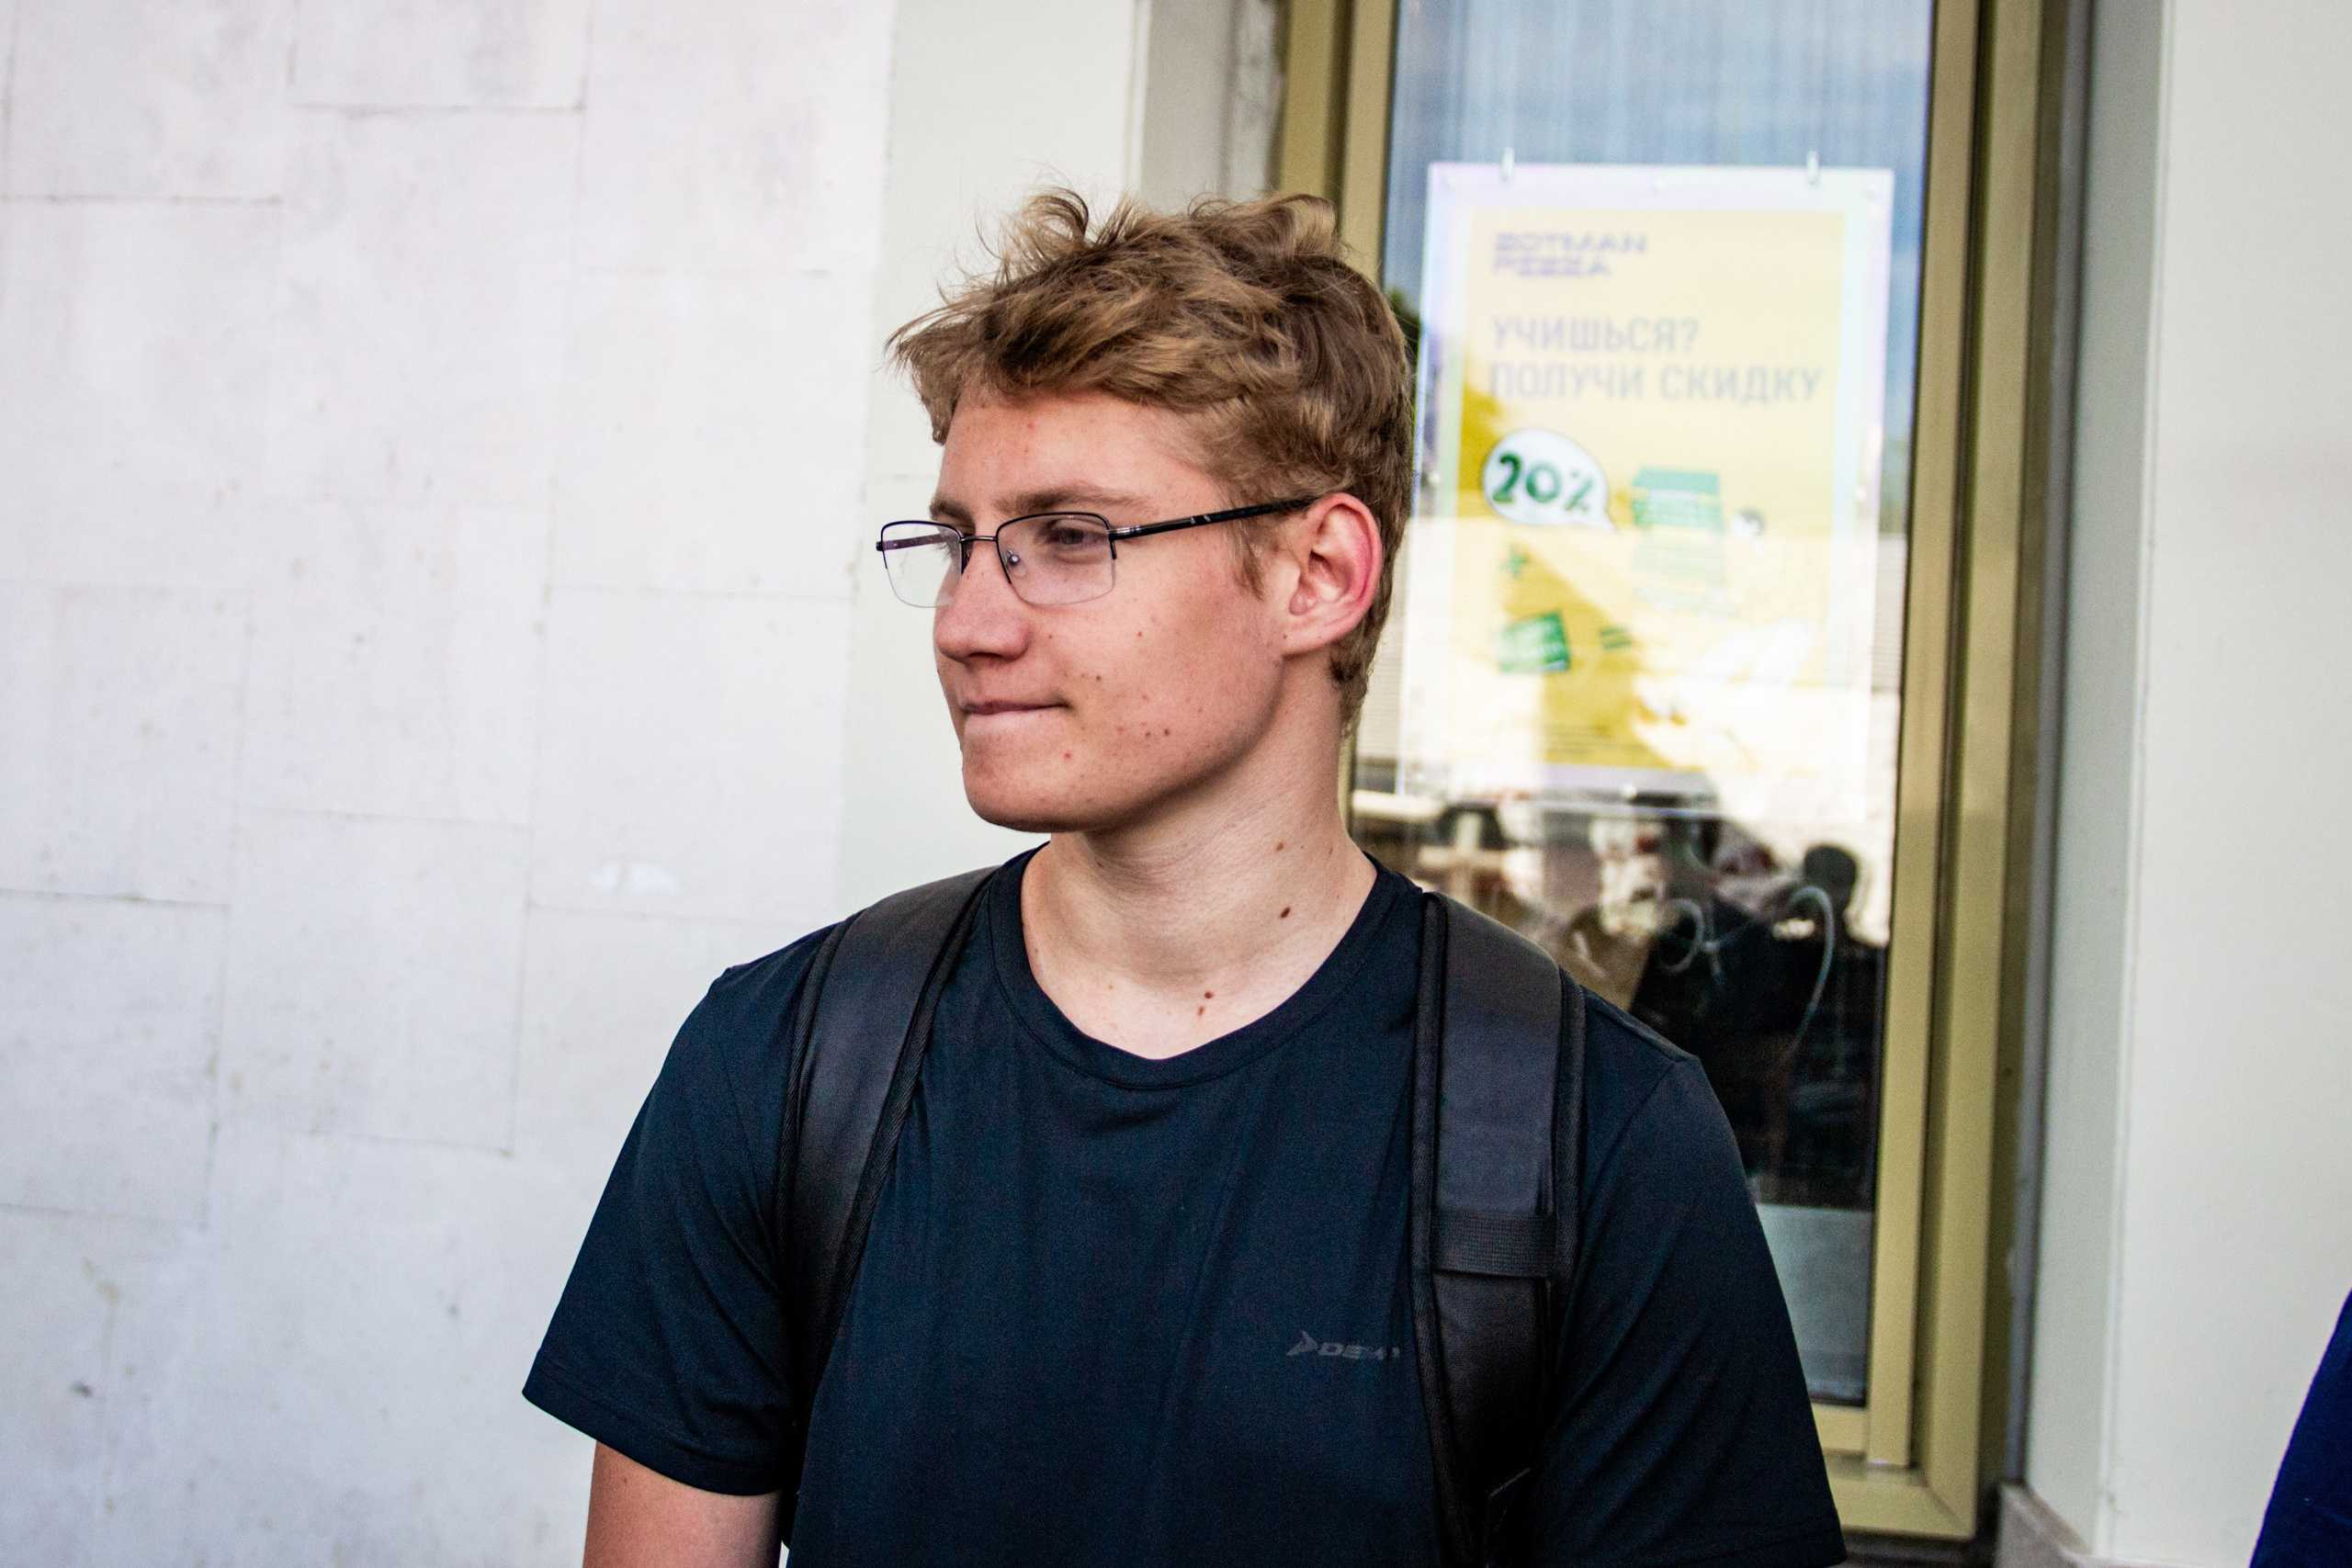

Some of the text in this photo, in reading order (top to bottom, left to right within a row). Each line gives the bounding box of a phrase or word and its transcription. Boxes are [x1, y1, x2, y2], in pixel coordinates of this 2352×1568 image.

[1491, 316, 1701, 353] УЧИШЬСЯ?
[1489, 363, 1823, 405] ПОЛУЧИ СКИДКУ
[1492, 451, 1594, 512] 20%
